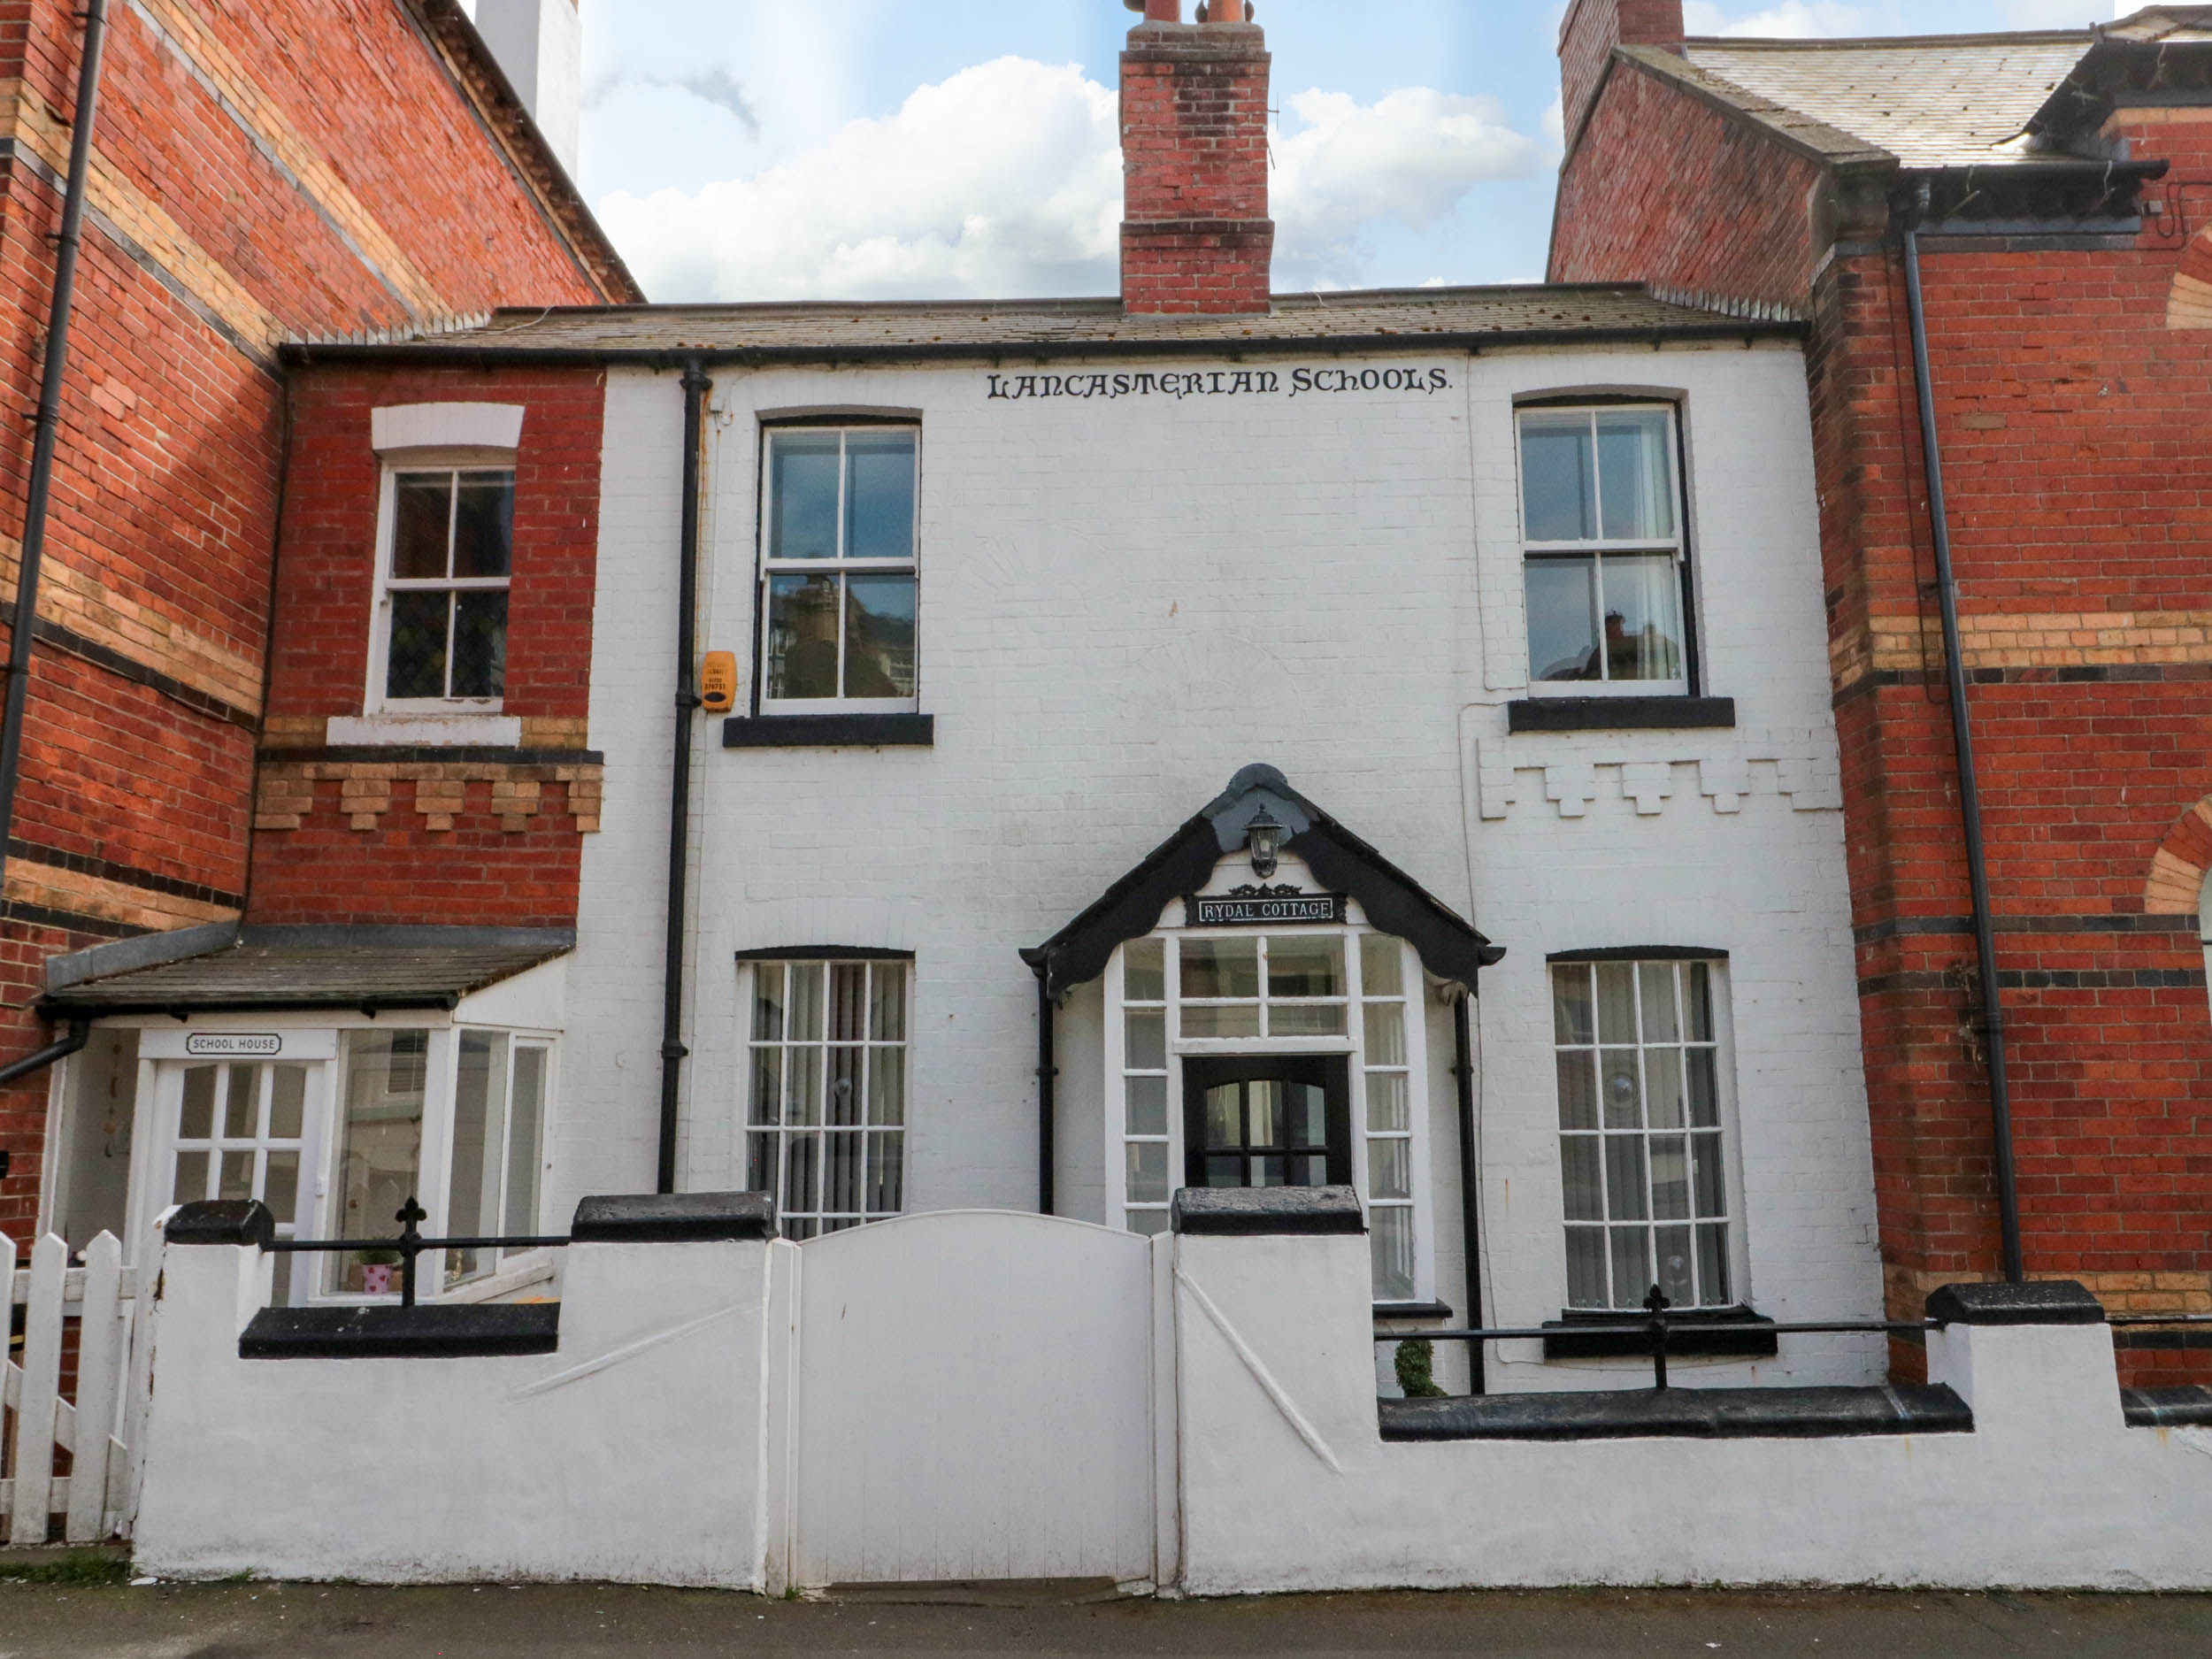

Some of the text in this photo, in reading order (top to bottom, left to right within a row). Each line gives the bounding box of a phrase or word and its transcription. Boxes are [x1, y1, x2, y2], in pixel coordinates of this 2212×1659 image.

[987, 369, 1279, 400] LANCASTERIAN
[1204, 902, 1330, 918] RYDAL COTTAGE
[193, 1039, 275, 1049] SCHOOL HOUSE
